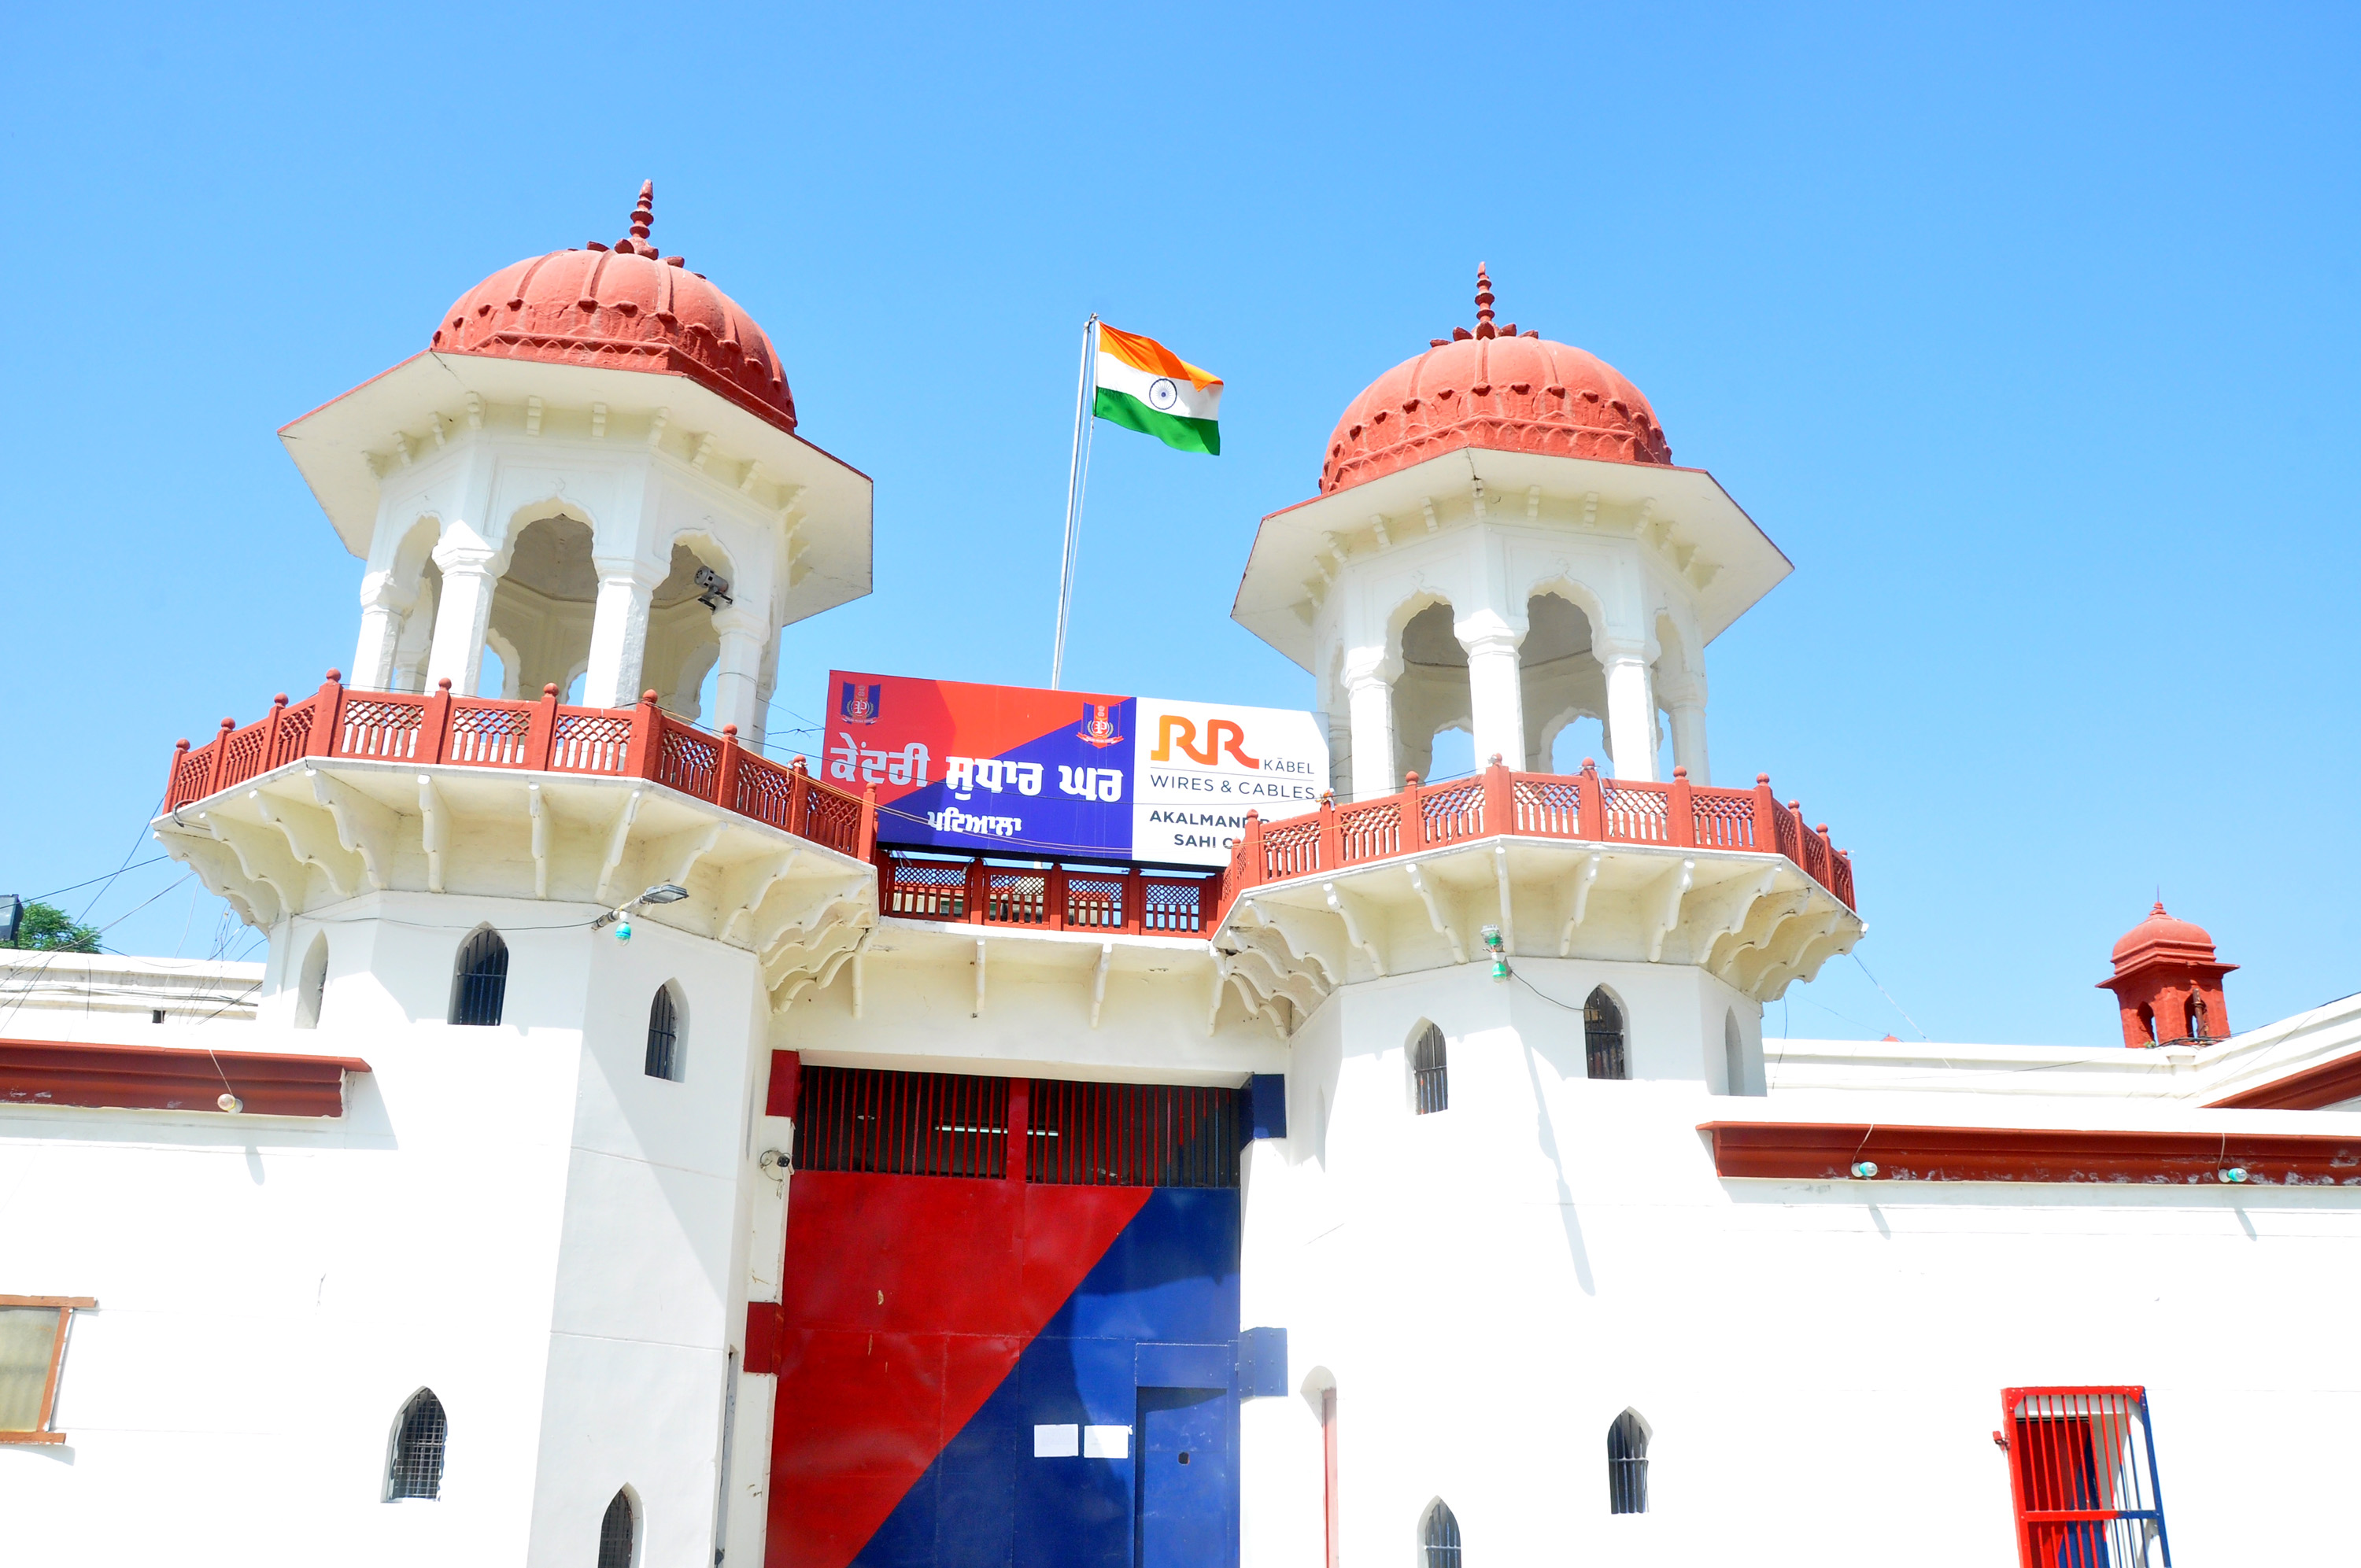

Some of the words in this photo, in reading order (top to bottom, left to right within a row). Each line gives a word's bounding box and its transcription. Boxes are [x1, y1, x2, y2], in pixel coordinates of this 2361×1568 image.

[1150, 714, 1260, 769] RR
[1263, 757, 1315, 775] KĀBEL
[830, 732, 931, 788] ਕੇਂਦਰੀ
[945, 755, 1044, 801] ਸੁਧਾਰ
[1058, 765, 1124, 802] ਘਰ
[1150, 774, 1214, 792] WIRES
[1220, 780, 1232, 793] &
[1238, 781, 1316, 800] CABLES
[927, 806, 1022, 836] ਪਟਿਆਲਾ
[1173, 833, 1217, 849] SAHI
